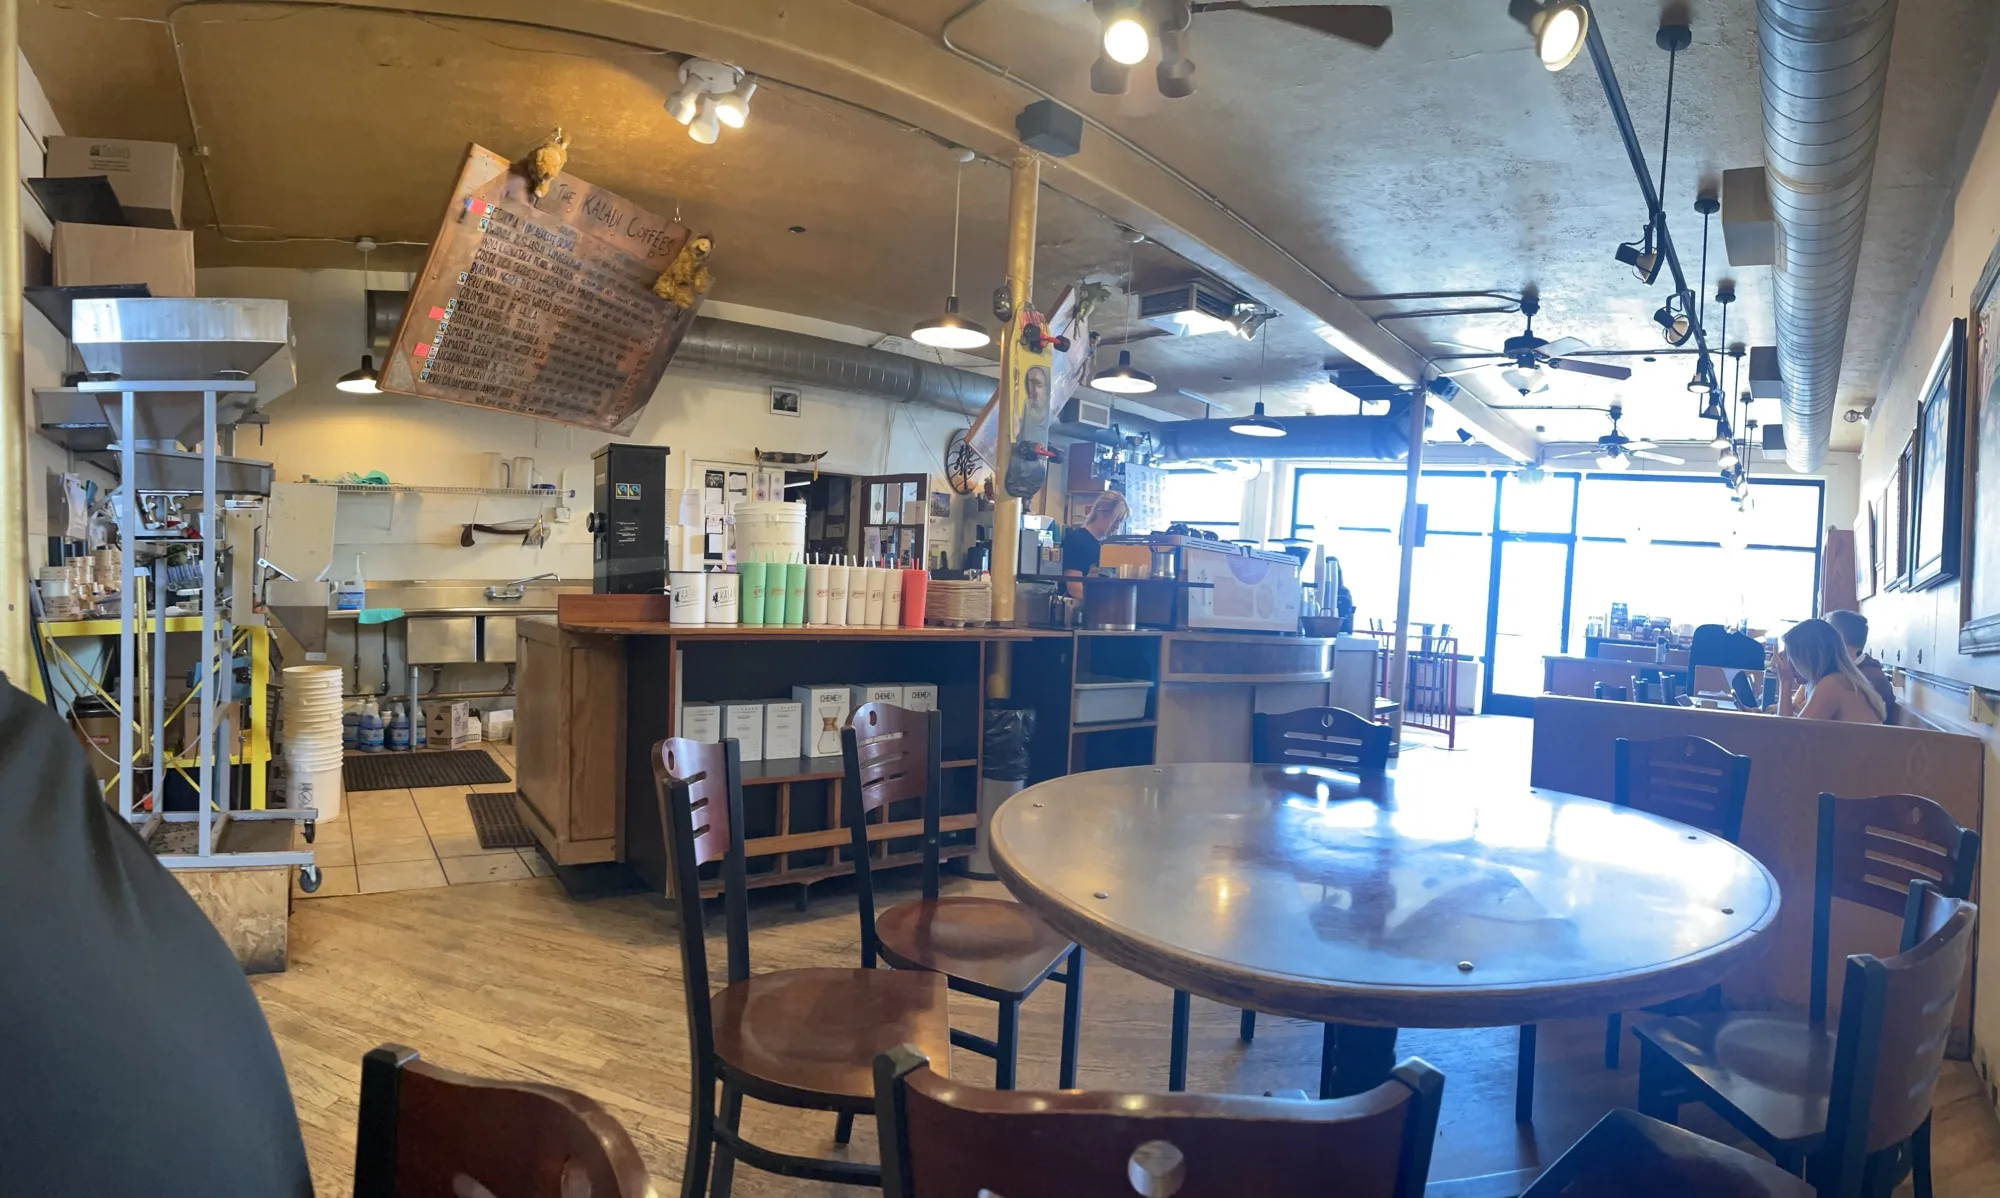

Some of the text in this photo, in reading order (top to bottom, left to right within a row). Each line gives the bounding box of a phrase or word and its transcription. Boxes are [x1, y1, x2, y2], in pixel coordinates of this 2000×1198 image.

[582, 195, 623, 227] KALADI
[627, 218, 675, 256] COFFEES
[481, 236, 499, 250] INDIA
[475, 248, 496, 263] COSTA
[470, 261, 498, 279] BURUNDI
[459, 286, 491, 305] COLOMBIA
[465, 274, 483, 288] PERU
[531, 297, 553, 311] WATER
[552, 304, 570, 318] DECAF
[454, 299, 478, 314] MEXICO
[450, 311, 485, 329] GUATEMALA
[445, 324, 475, 341] SUMATRA
[441, 336, 471, 352] SUMATRA
[431, 360, 456, 374] BOLIVIA
[426, 373, 443, 384] PERU
